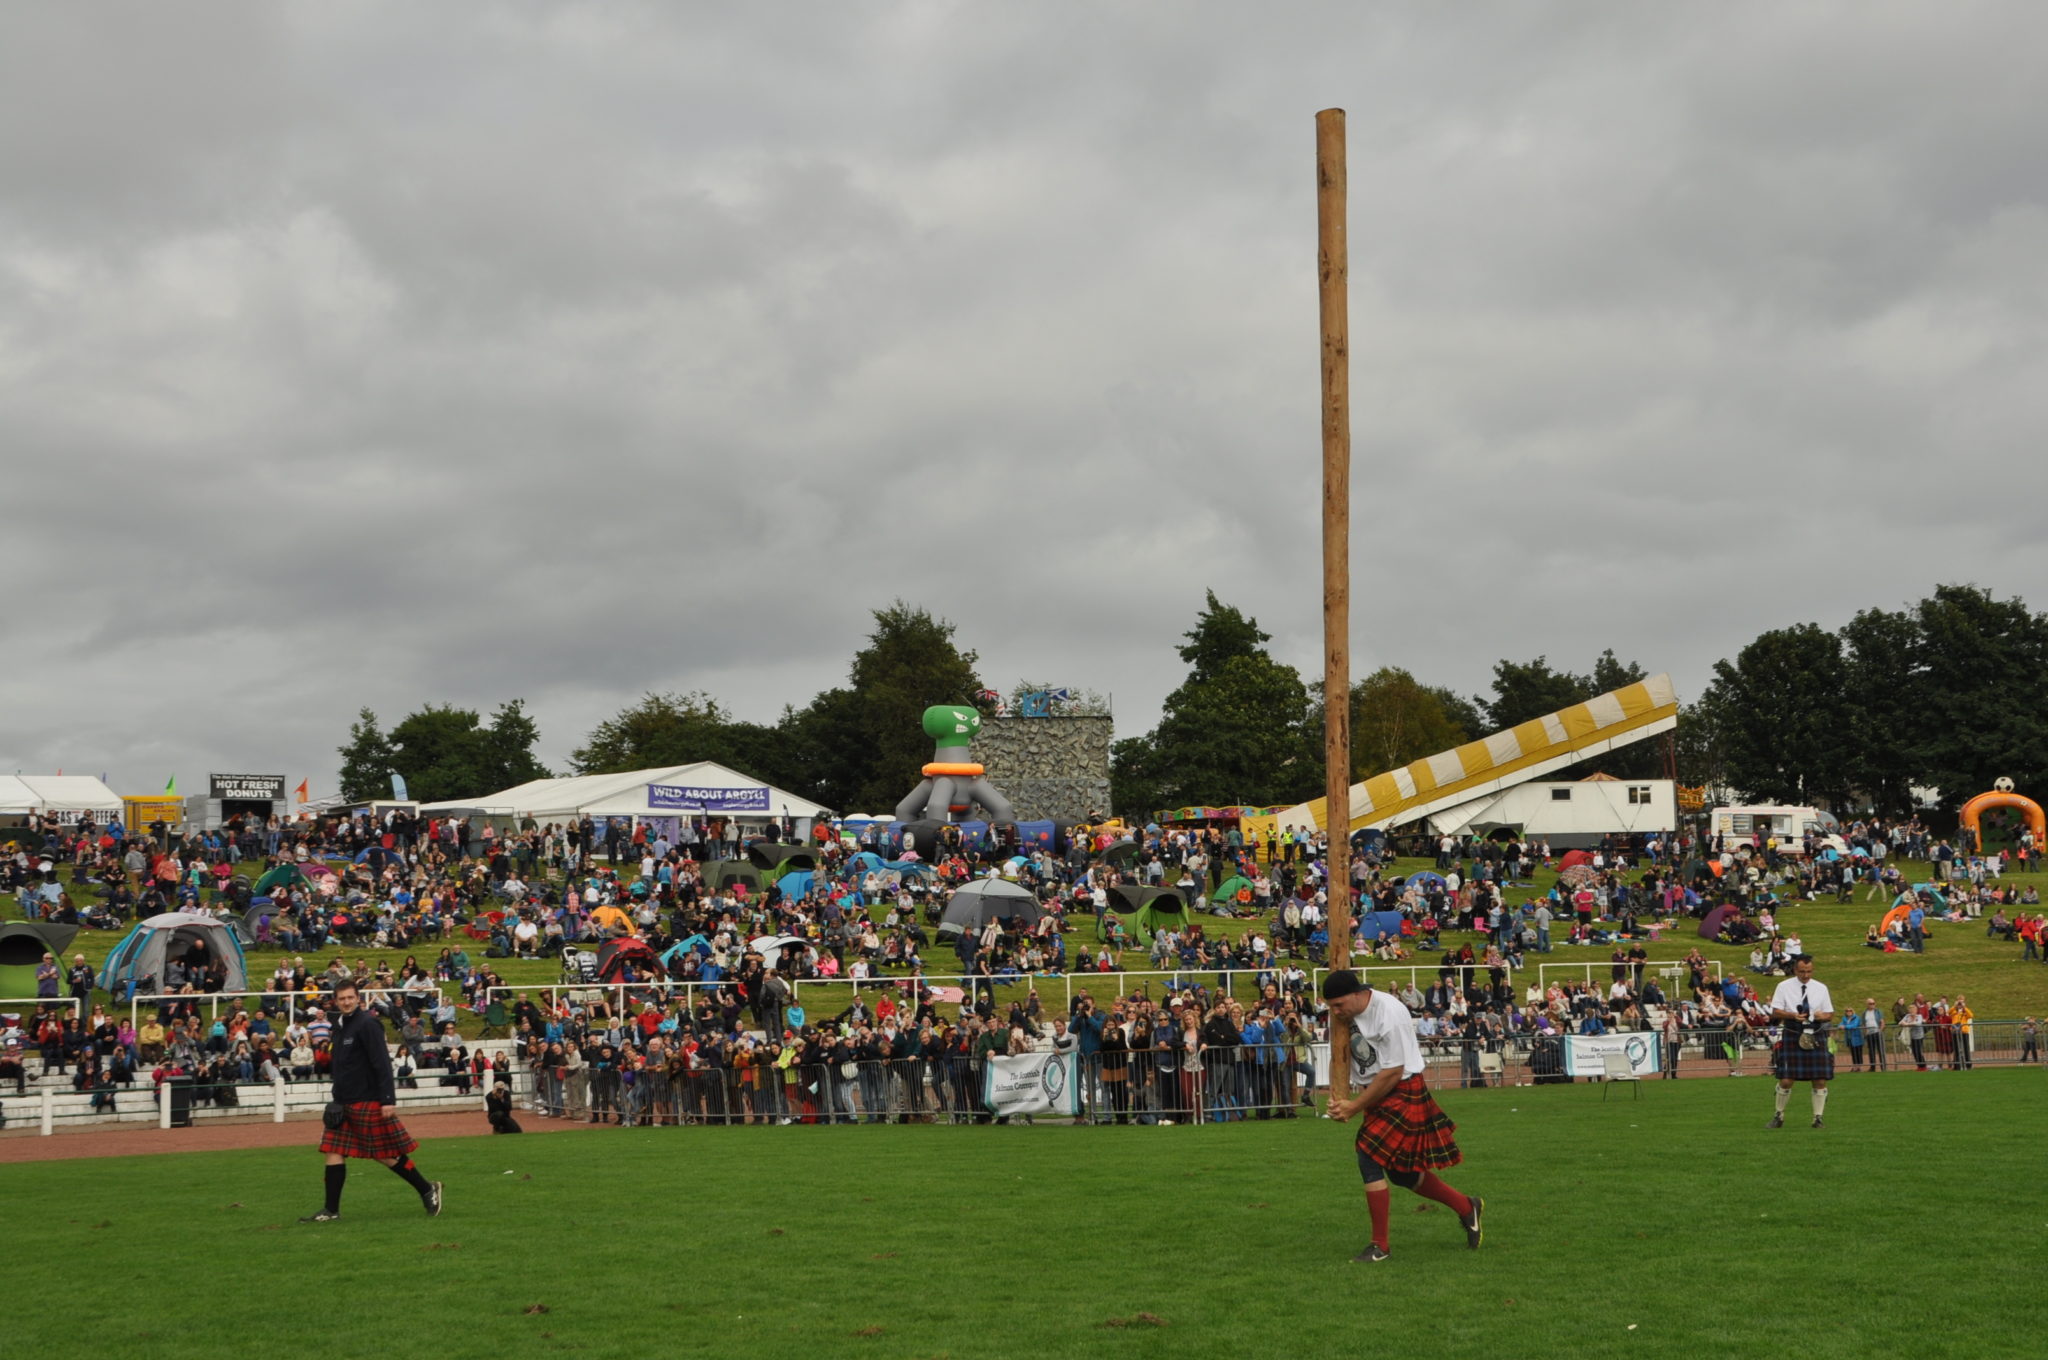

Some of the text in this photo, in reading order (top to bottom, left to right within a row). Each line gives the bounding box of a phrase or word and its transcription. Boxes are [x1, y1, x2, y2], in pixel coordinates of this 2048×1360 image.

[1023, 691, 1050, 717] K2
[216, 780, 278, 789] HOT FRESH
[226, 789, 272, 798] DONUTS
[653, 786, 765, 800] WILD ABOUT ARGYLL
